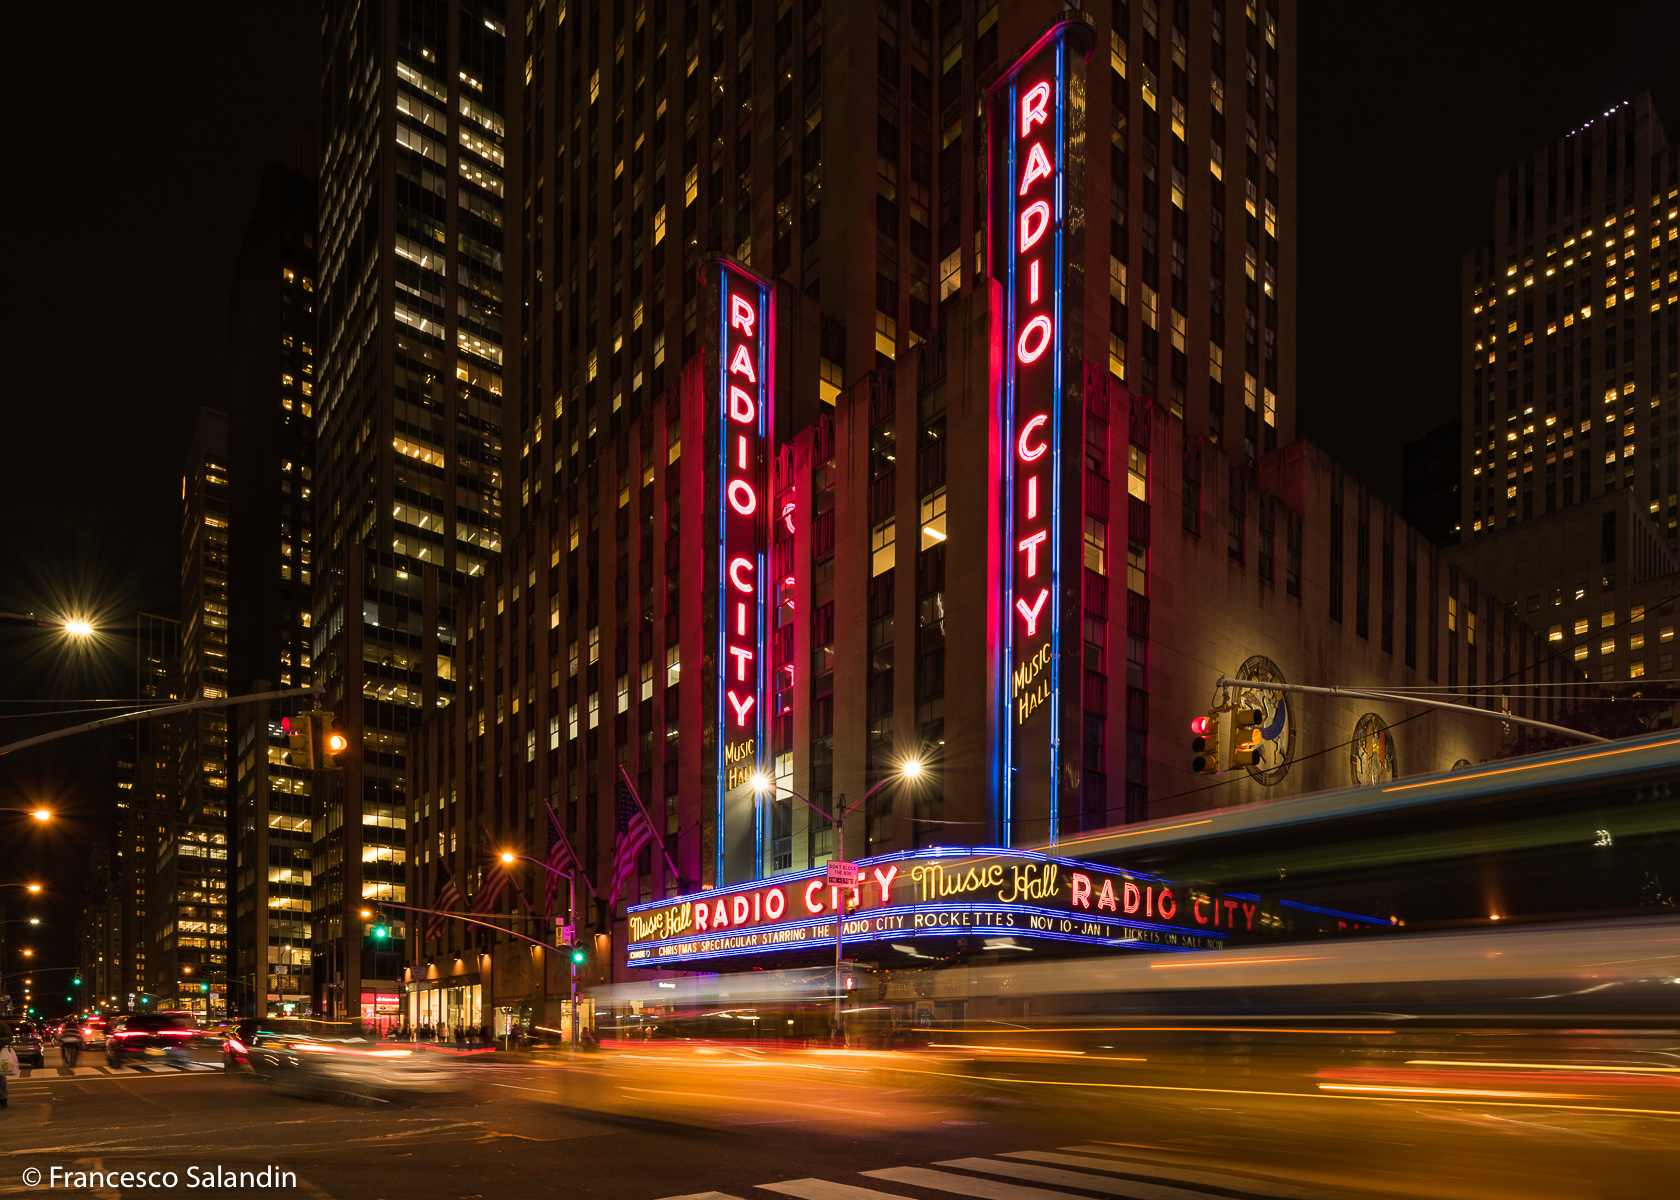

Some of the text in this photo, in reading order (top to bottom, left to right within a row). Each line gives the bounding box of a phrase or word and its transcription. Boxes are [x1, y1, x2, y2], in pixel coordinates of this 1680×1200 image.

[1017, 81, 1052, 364] RADIO
[728, 294, 757, 516] RADIO
[1016, 413, 1049, 637] CITY
[727, 556, 756, 728] CITY
[1019, 678, 1051, 725] HALL
[725, 738, 755, 767] MUSIC
[911, 864, 1059, 902] Music Hall
[1072, 872, 1257, 931] RADIO CITY
[630, 901, 692, 942] Music Hall
[695, 887, 786, 931] RADIO
[658, 942, 697, 957] CHRISTMAS
[701, 934, 757, 952] SPECTACULAR
[762, 928, 806, 945] STARRING
[812, 925, 830, 938] THE
[843, 920, 869, 935] ADIO
[876, 916, 904, 931] CITY
[914, 912, 1014, 928] ROCKETTES
[1030, 915, 1053, 931] NOV
[1123, 927, 1160, 943] TICKETS
[1165, 933, 1177, 945] ON
[1182, 935, 1202, 948] SALE
